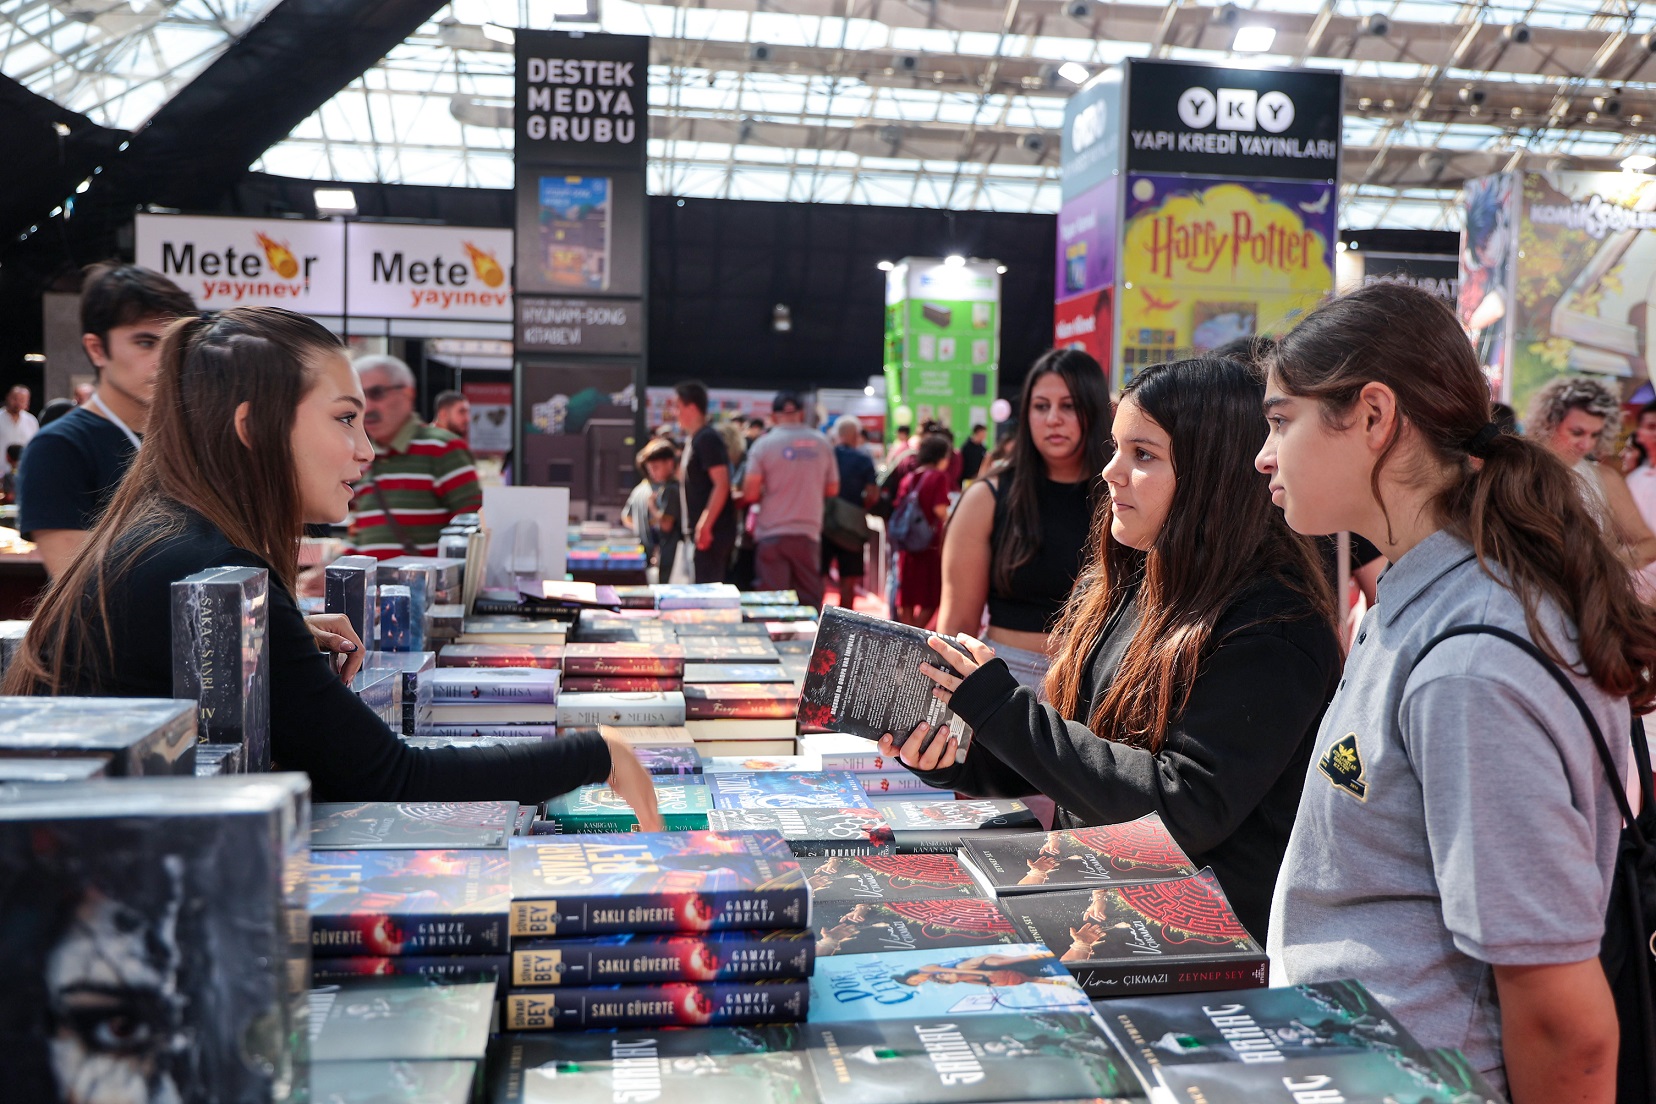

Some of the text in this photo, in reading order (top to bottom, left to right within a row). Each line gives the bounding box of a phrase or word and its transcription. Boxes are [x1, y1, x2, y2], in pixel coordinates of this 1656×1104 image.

[527, 57, 635, 87] DESTEK
[527, 86, 634, 115] MEDYA
[526, 114, 635, 144] GRUBU
[1131, 129, 1336, 160] YAPI KREDİ YAYINLARI
[1143, 213, 1229, 280] Harry
[1230, 210, 1316, 283] Potter
[201, 597, 213, 640] SAKA
[201, 649, 214, 690] SANRI
[491, 686, 533, 698] MEHSA
[627, 712, 666, 723] MEHSA
[527, 843, 594, 886] SÜVARİ
[583, 843, 660, 874] BEY
[592, 909, 626, 924] SAKLI
[627, 905, 676, 923] GÜVERTE
[724, 899, 769, 911] GAMZE
[530, 905, 548, 932] BEY
[717, 908, 776, 923] AYDENİZ
[311, 928, 363, 945] GÜVERTE
[418, 921, 466, 934] GAMZE
[1132, 919, 1161, 950] ÇIKMAZI
[410, 933, 473, 947] AYDENİZ
[597, 958, 630, 974] SAKLI
[632, 955, 682, 972] GÜVERTE
[731, 949, 776, 962] GAMZE
[533, 955, 553, 982] BEY
[724, 958, 783, 973] AYDENİZ
[1122, 973, 1169, 987] ÇIKMAZI
[1178, 972, 1222, 983] ZEYNEP
[1224, 970, 1246, 980] SEY
[725, 991, 769, 1004] GAMZE
[527, 999, 547, 1026] BEY
[591, 1003, 624, 1017] SAKLI
[626, 999, 676, 1016] GÜVERTE
[717, 1002, 776, 1016] AYDENİZ
